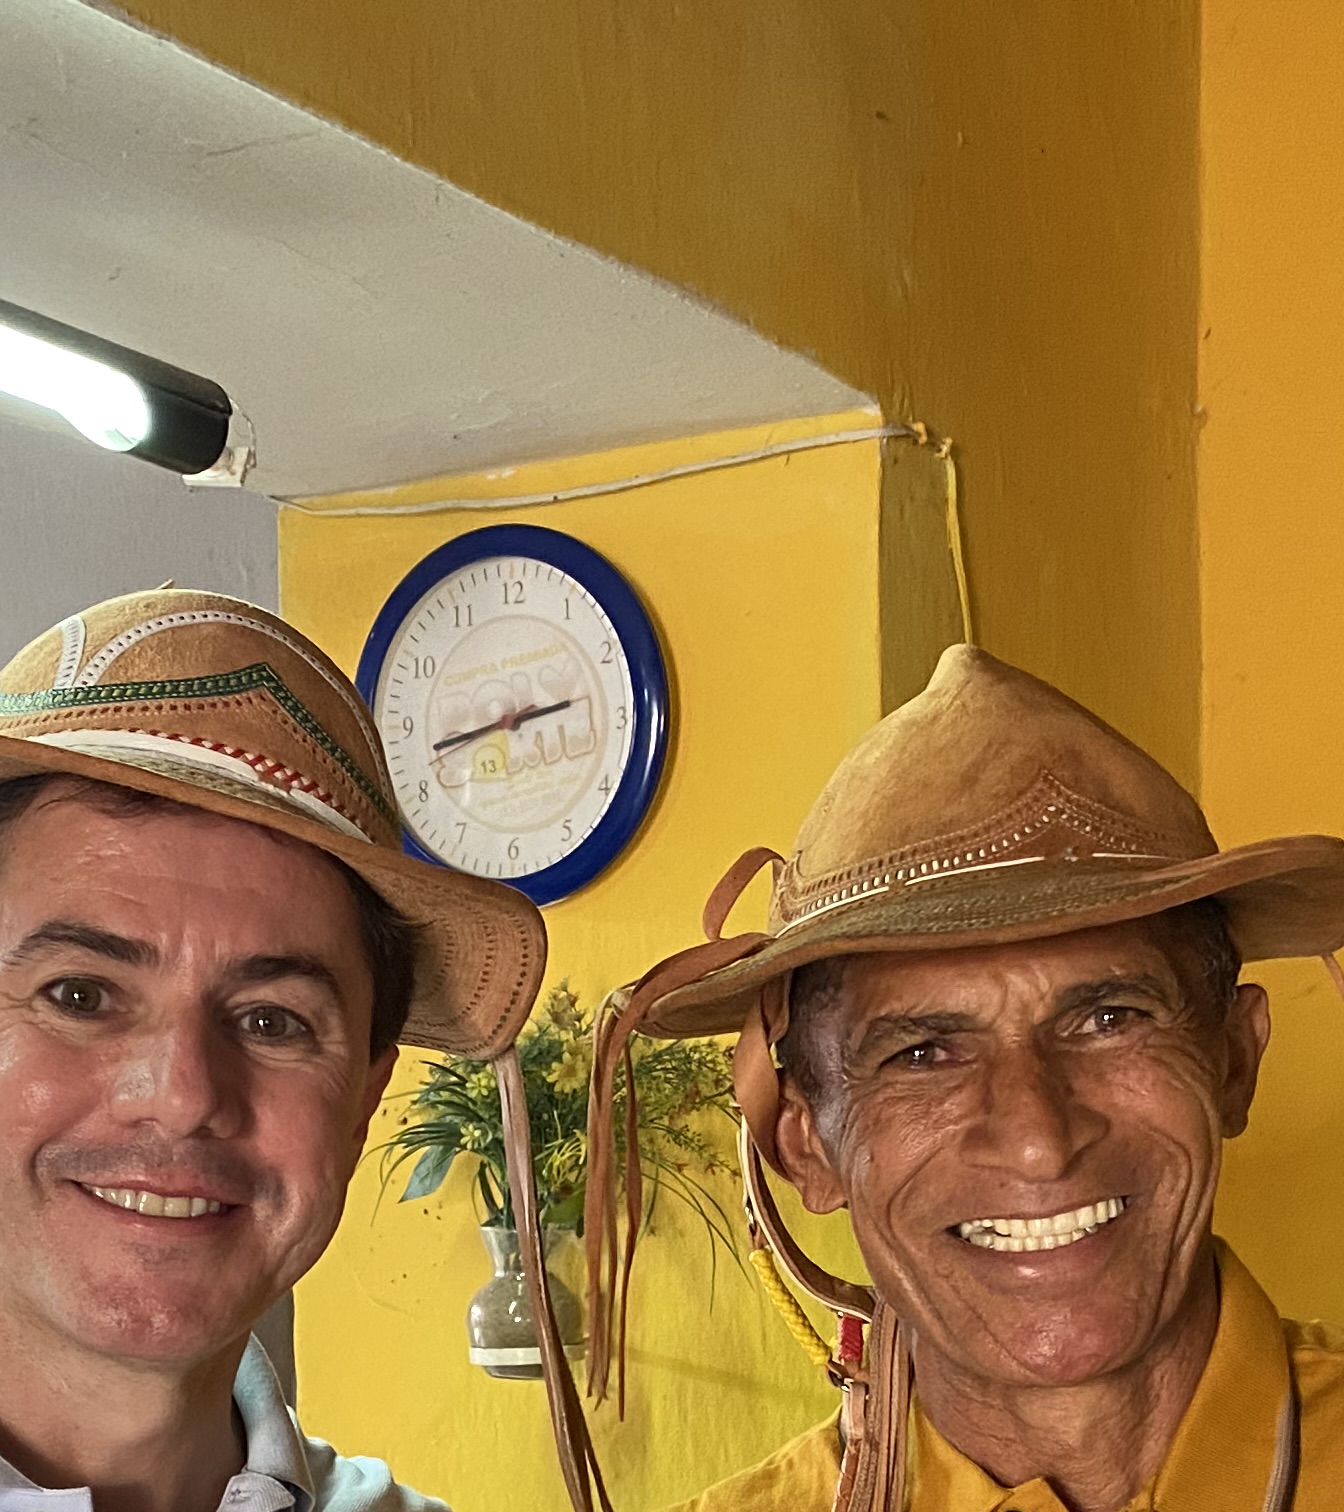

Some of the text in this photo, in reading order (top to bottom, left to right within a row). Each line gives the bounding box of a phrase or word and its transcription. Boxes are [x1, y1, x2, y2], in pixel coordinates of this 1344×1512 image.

[502, 581, 524, 604] 12
[453, 604, 473, 628] 11
[562, 599, 571, 620] 1
[600, 641, 614, 664] 2
[413, 655, 435, 679] 10
[403, 716, 414, 739] 9
[616, 706, 627, 730] 3
[418, 780, 430, 803] 8
[598, 773, 612, 795] 4
[455, 822, 467, 844] 7
[560, 819, 573, 841] 5
[508, 838, 520, 860] 6
